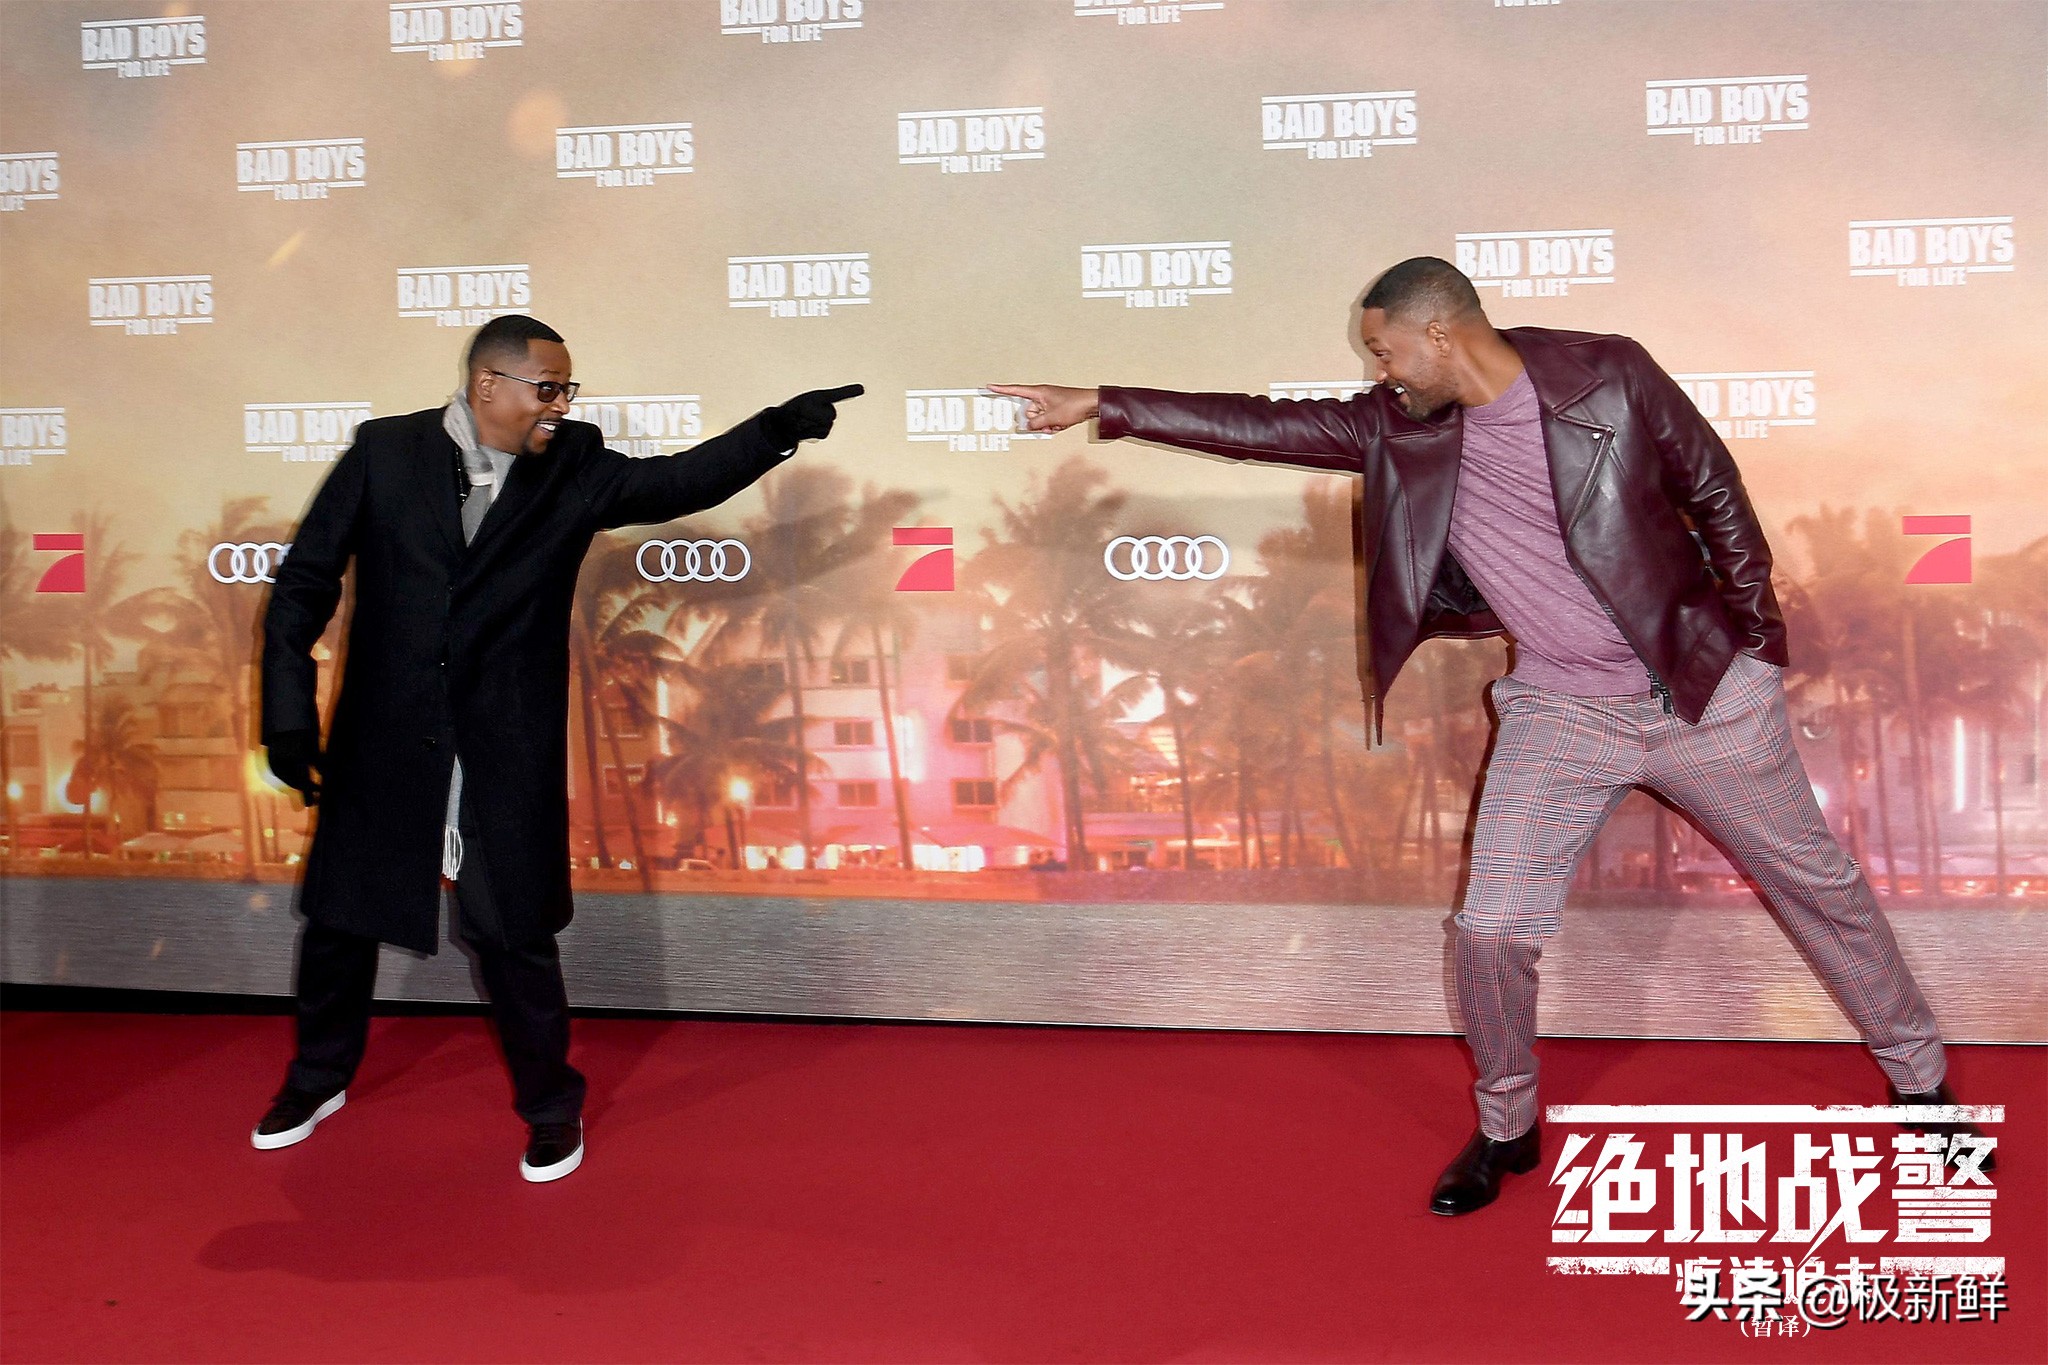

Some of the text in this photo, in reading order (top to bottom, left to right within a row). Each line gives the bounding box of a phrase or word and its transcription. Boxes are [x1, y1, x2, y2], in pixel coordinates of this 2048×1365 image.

[721, 0, 862, 25] BAD BOYS
[1118, 5, 1181, 25] FOR LIFE
[390, 6, 521, 44] BAD BOYS
[763, 23, 823, 43] FOR LIFE
[82, 24, 205, 61] BAD BOYS
[428, 43, 485, 61] FOR LIFE
[118, 60, 171, 78] FOR LIFE
[1647, 82, 1808, 125] BAD BOYS
[1263, 99, 1416, 139] BAD BOYS
[899, 115, 1044, 154] BAD BOYS
[1694, 124, 1764, 145] FOR LIFE
[557, 130, 692, 169] BAD BOYS
[1307, 139, 1374, 159] FOR LIFE
[237, 146, 364, 183] BAD BOYS
[941, 154, 1004, 173] FOR LIFE
[596, 168, 655, 187] FOR LIFE
[274, 182, 329, 200] FOR LIFE
[1850, 225, 2013, 266] BAD BOYS
[1456, 238, 1614, 277] BAD BOYS
[729, 259, 869, 298] BAD BOYS
[1082, 249, 1231, 290] BAD BOYS
[1898, 266, 1968, 286] FOR LIFE
[398, 272, 529, 308] BAD BOYS
[1125, 289, 1190, 308] FOR LIFE
[1503, 277, 1571, 297] FOR LIFE
[90, 283, 212, 317] BAD BOYS
[770, 298, 830, 317] FOR LIFE
[125, 317, 178, 335] FOR LIFE
[436, 310, 462, 326] FOR
[1728, 379, 1815, 417] BOYS
[244, 409, 372, 443] BAD BOY
[627, 402, 700, 436] BOYS
[907, 397, 965, 432] BAD
[2, 415, 66, 447] BOYS
[1735, 419, 1768, 438] LIFE
[282, 445, 306, 462] FOR
[949, 434, 1010, 452] FOR LIFE
[8, 449, 32, 466] LIFE
